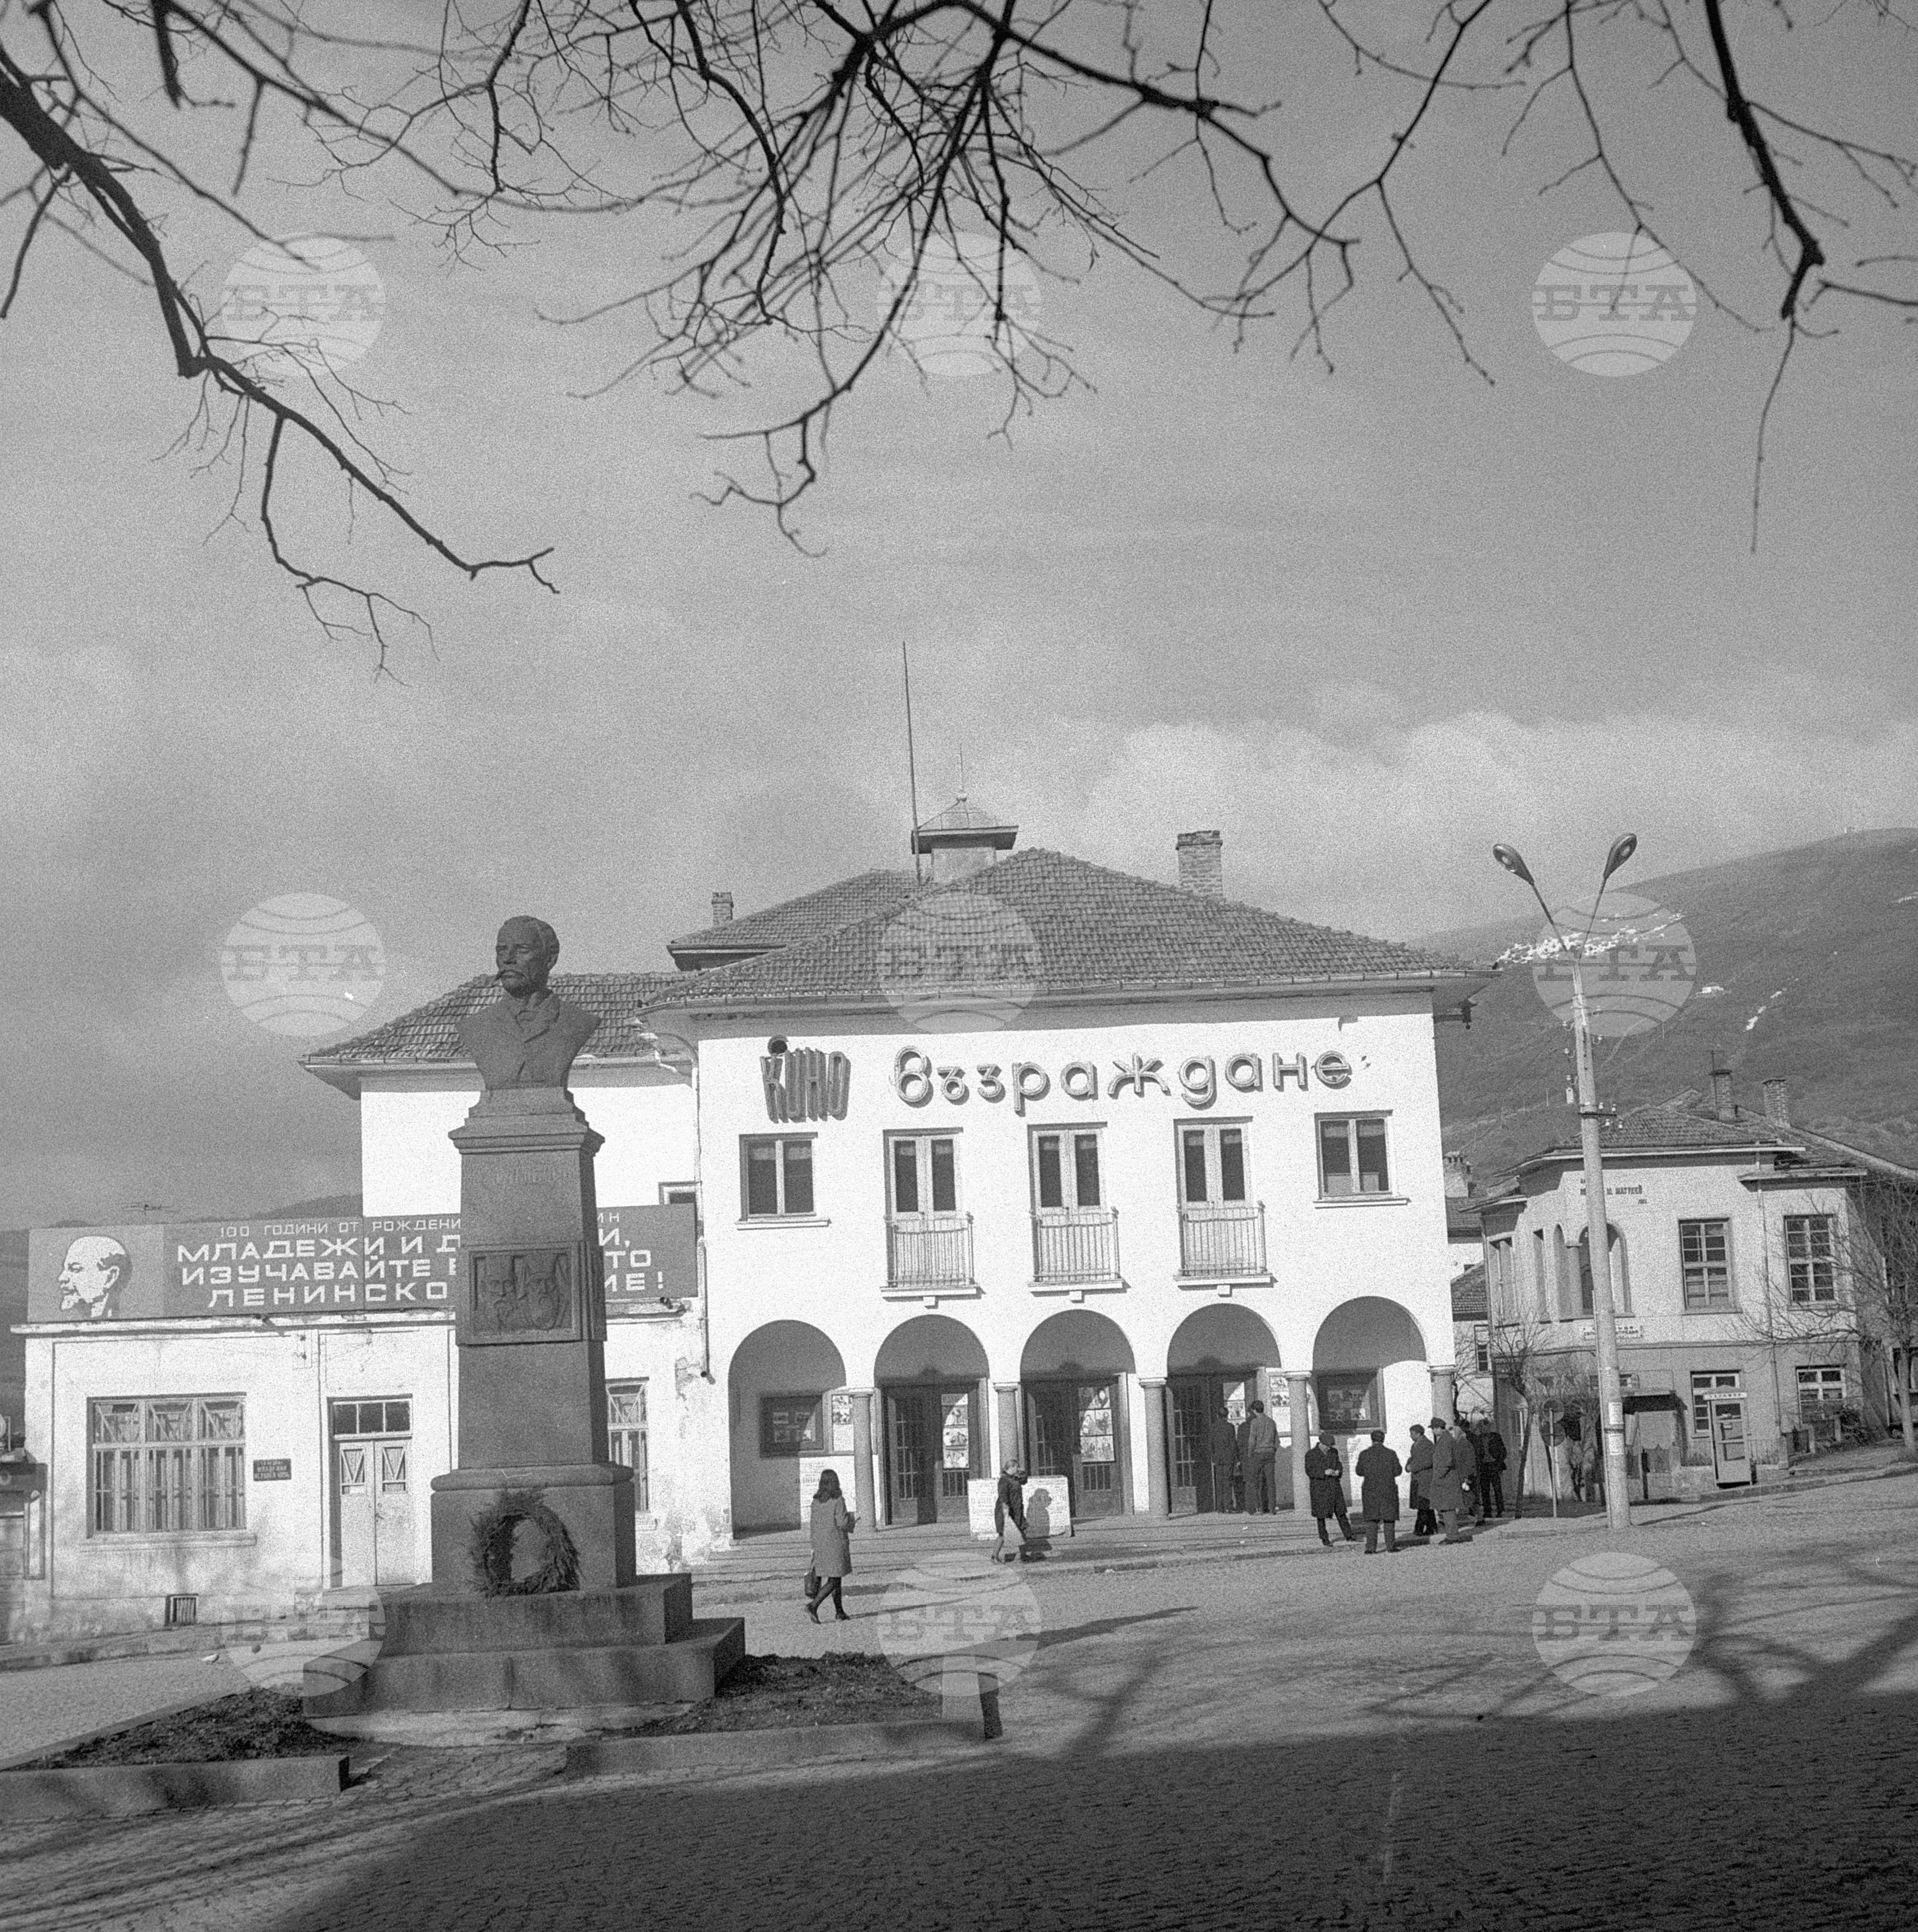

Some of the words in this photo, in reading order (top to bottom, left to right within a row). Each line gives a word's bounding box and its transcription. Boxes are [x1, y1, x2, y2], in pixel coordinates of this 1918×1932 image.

[220, 1226, 249, 1237] 100
[264, 1223, 328, 1235] ГОДИНИ
[339, 1222, 358, 1232] ОТ
[372, 1219, 460, 1231] РОЖДЕНИ
[178, 1236, 384, 1262] МЛАДЕЖИ
[401, 1236, 423, 1254] И
[182, 1256, 430, 1285] ИЗУЧАВАЙТЕ
[207, 1281, 447, 1308] ЛЕНИНСКО
